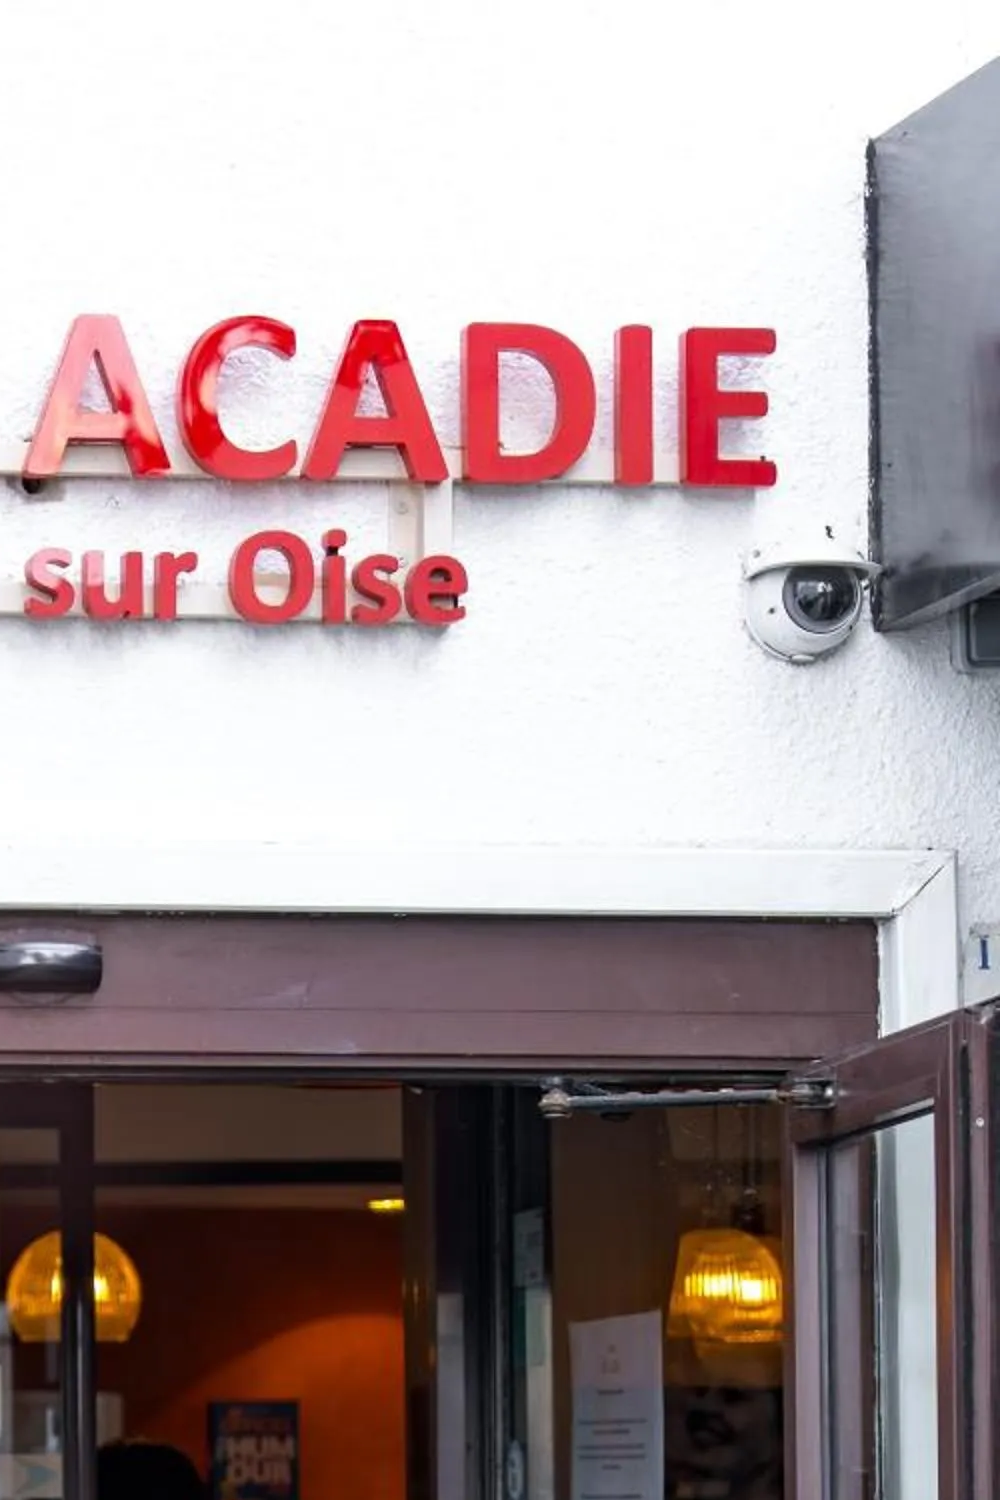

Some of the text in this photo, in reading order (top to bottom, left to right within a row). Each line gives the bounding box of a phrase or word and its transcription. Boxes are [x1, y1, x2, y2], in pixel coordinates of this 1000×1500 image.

[21, 313, 778, 487] ACADIE
[23, 547, 198, 623] sur
[227, 528, 469, 626] Oise
